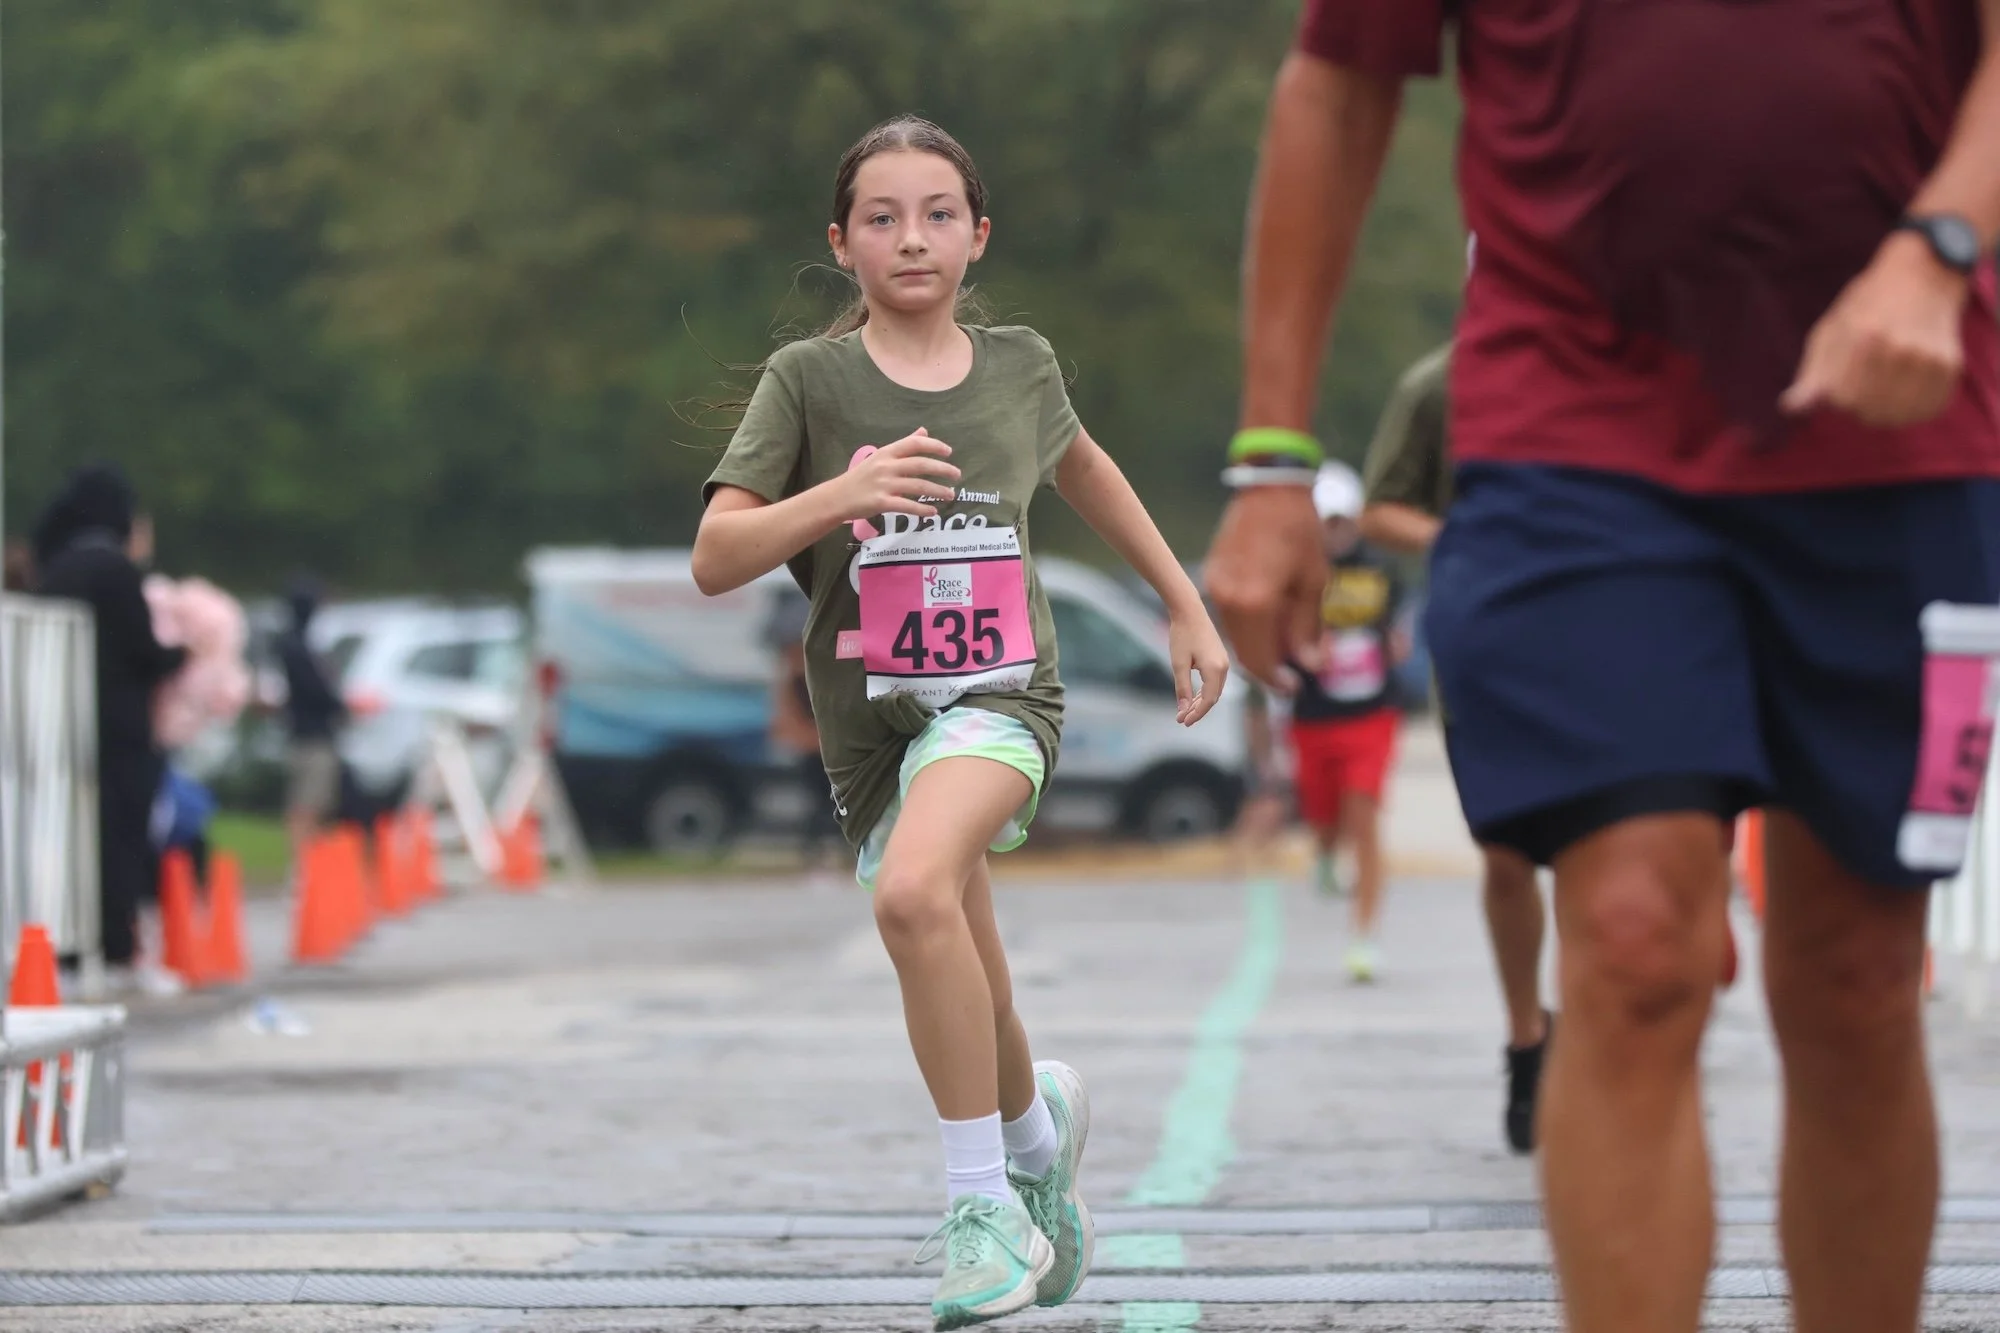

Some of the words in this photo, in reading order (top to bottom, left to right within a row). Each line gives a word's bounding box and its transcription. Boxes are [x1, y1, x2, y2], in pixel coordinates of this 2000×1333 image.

[957, 488, 1000, 504] Annual
[866, 548, 899, 559] Cleveland
[901, 546, 921, 555] Clinic
[923, 545, 949, 555] Medina
[951, 544, 978, 554] Hospital
[979, 543, 1002, 552] Medical
[1003, 542, 1016, 550] Staff
[930, 587, 963, 598] Grace
[938, 579, 962, 590] Race
[891, 608, 1005, 670] 435
